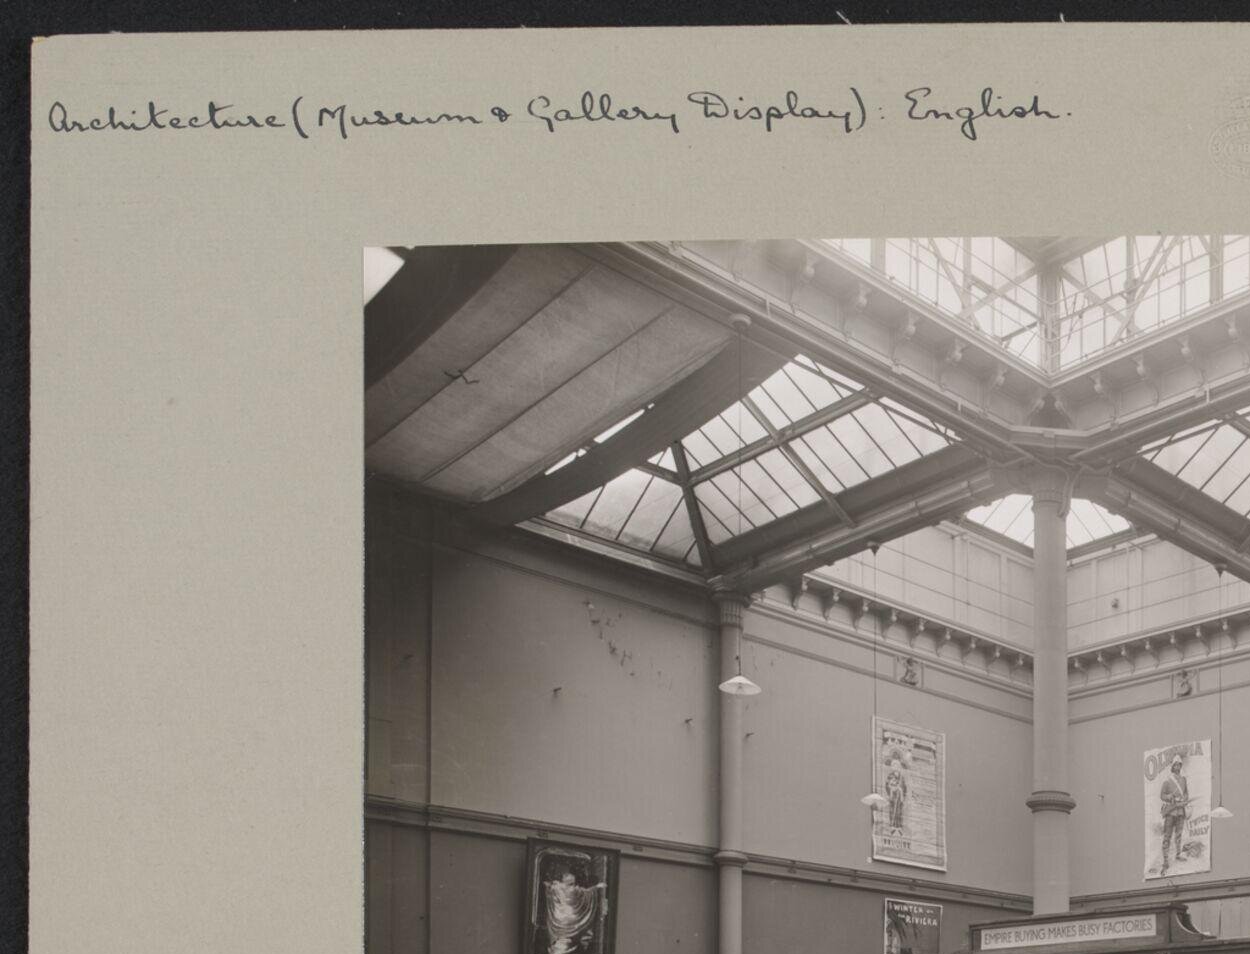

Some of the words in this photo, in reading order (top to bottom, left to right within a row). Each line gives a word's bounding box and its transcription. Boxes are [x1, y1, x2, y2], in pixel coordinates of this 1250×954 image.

[528, 91, 680, 134] Gallery
[905, 914, 938, 927] RIVIERA
[984, 930, 1012, 946] EMPIRE
[1014, 928, 1046, 944] BUYING
[1048, 925, 1077, 940] MAKES
[1078, 923, 1100, 937] BUSY
[1102, 918, 1153, 935] FACTORIES
